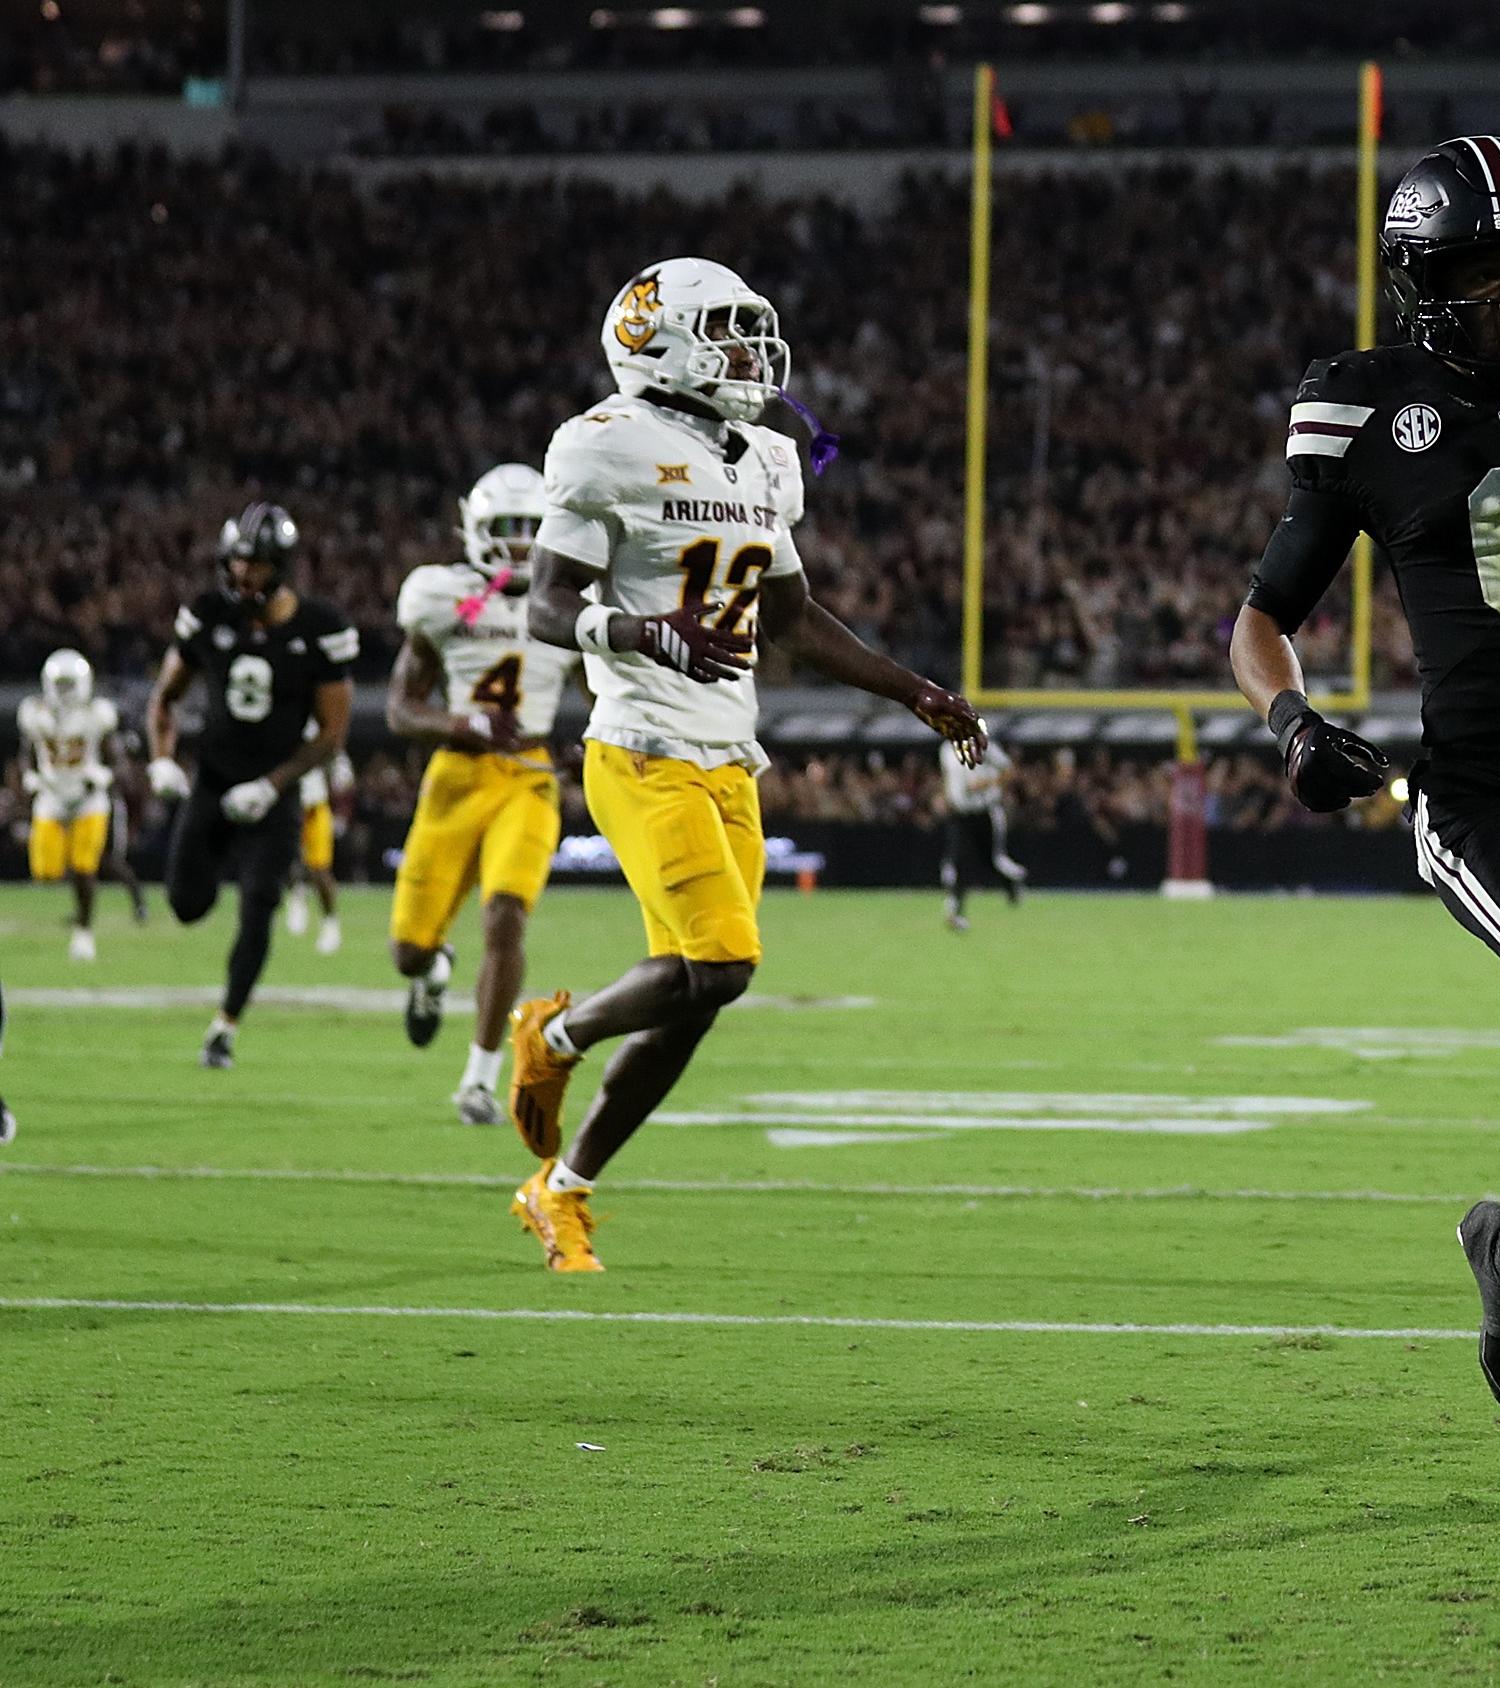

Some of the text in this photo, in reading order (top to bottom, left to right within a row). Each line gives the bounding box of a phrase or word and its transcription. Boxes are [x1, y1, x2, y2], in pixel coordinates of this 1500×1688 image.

[1385, 184, 1424, 229] tate
[1397, 408, 1436, 448] SEC
[662, 500, 749, 524] ARIZONA
[679, 537, 773, 656] 12
[227, 654, 273, 723] 8
[470, 652, 524, 719] 4
